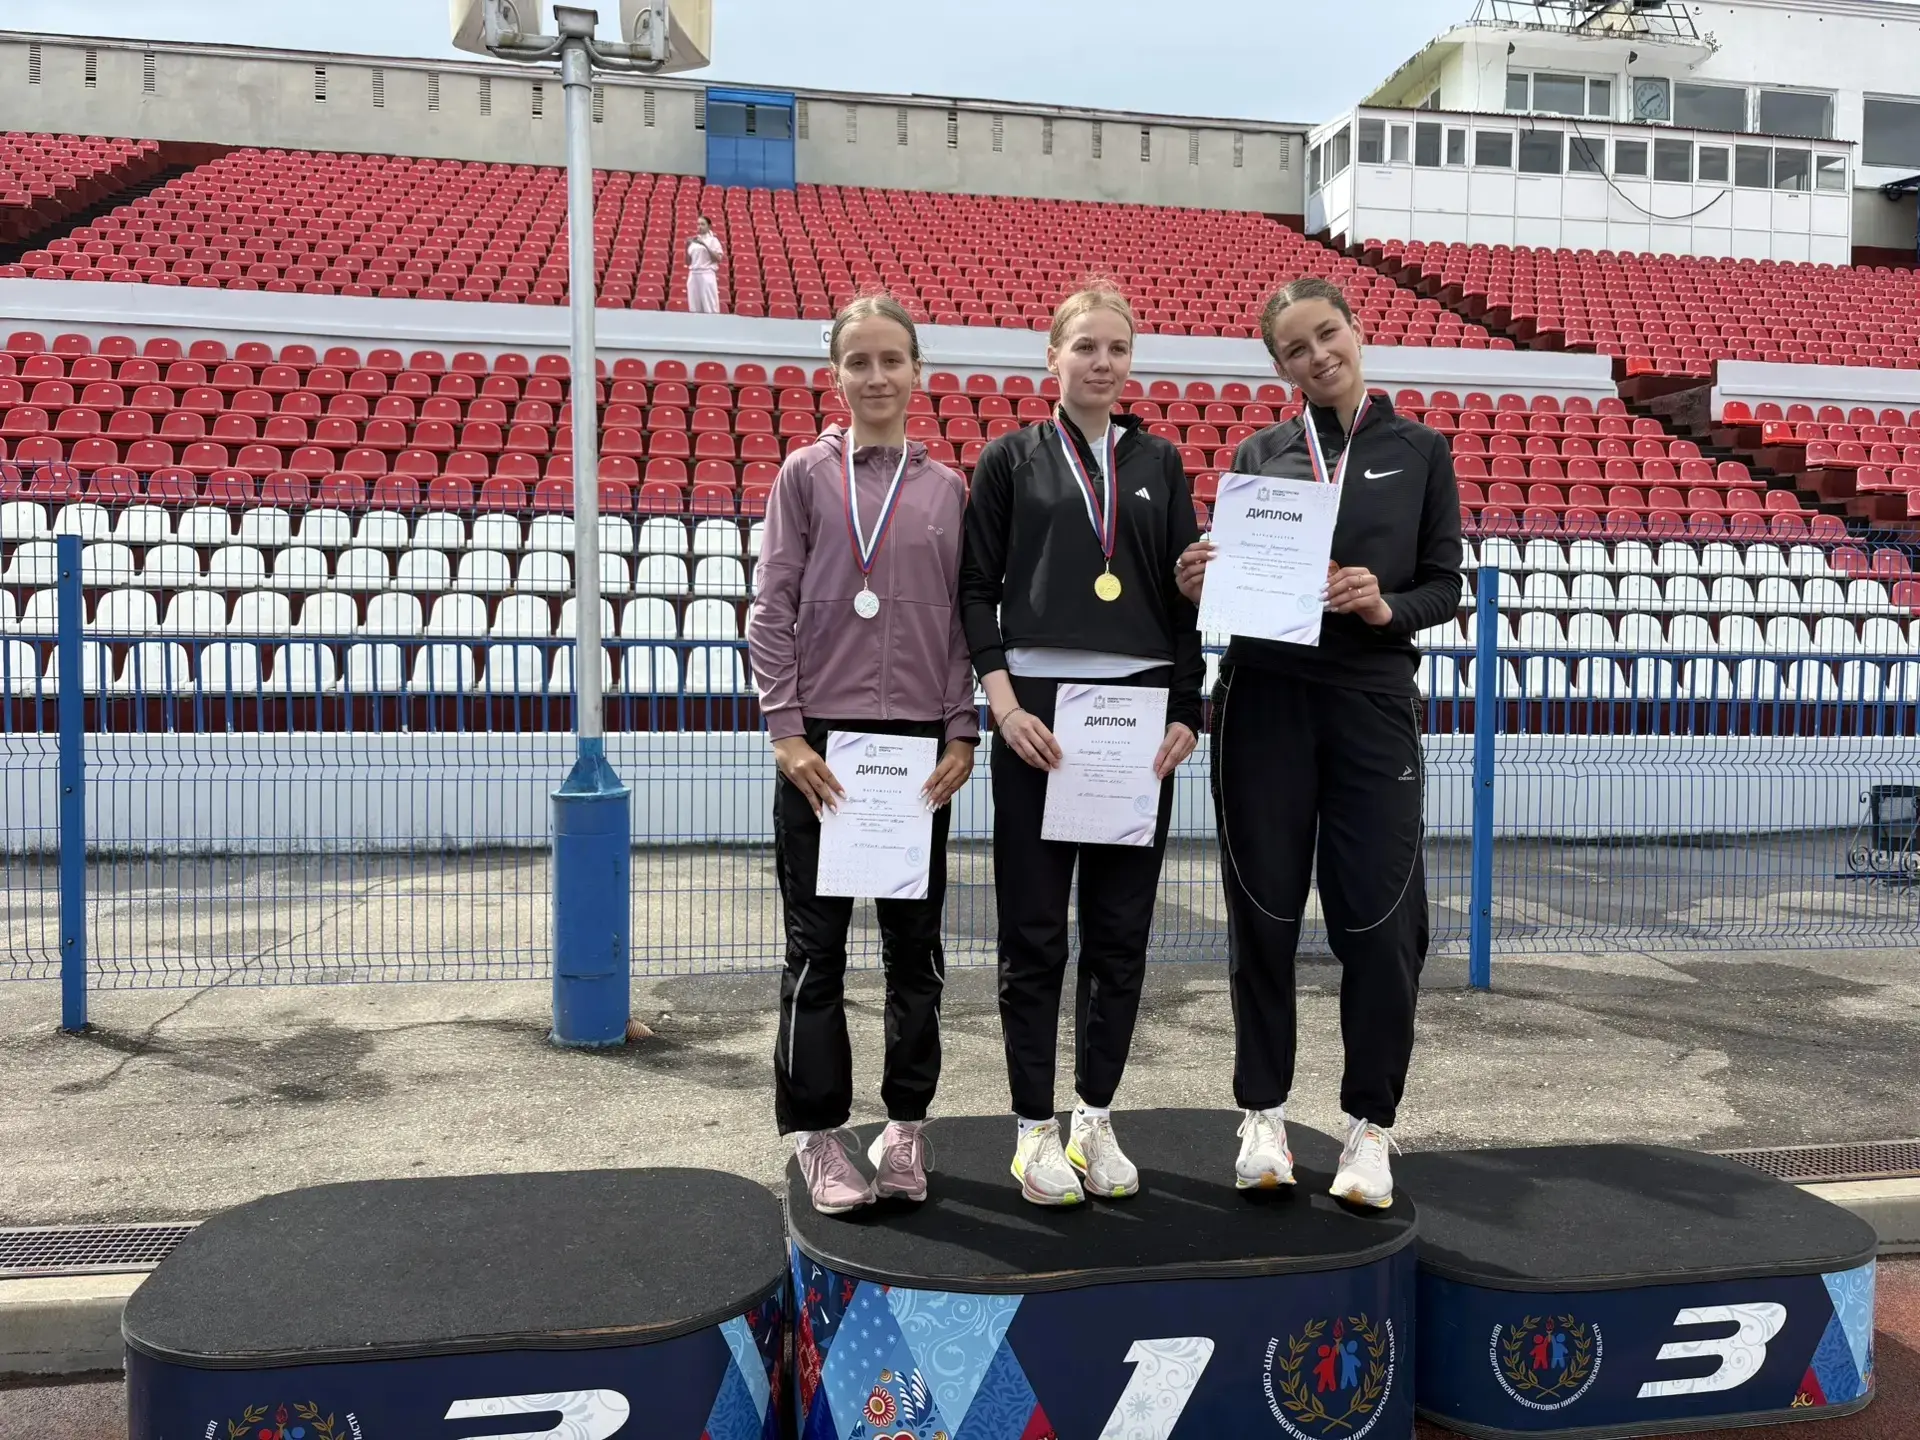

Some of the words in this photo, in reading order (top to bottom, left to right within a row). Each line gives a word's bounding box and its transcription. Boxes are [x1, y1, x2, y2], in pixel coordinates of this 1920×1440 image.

[1245, 507, 1303, 523] ДИПЛОМ
[1084, 716, 1137, 728] ДИПЛОМ
[855, 764, 908, 777] ДИПЛОМ
[1263, 1336, 1280, 1371] ЦЕНТР
[1385, 1317, 1396, 1363] ОБЛАСТИ
[1489, 1323, 1503, 1348] ЦЕНТР
[1591, 1322, 1603, 1357] ОБЛАСТИ
[1636, 1301, 1787, 1398] 3
[1097, 1336, 1215, 1440] 1
[1489, 1348, 1515, 1397] СПОРТИВНОЙ
[1560, 1357, 1602, 1408] НИЖЕГОРОДСКОЙ
[1262, 1372, 1296, 1434] СПОРТИВНОЙ
[1352, 1364, 1395, 1440] НИЖЕГОРОДСКОЙ
[1513, 1394, 1560, 1411] ПОДГОТОВКИ
